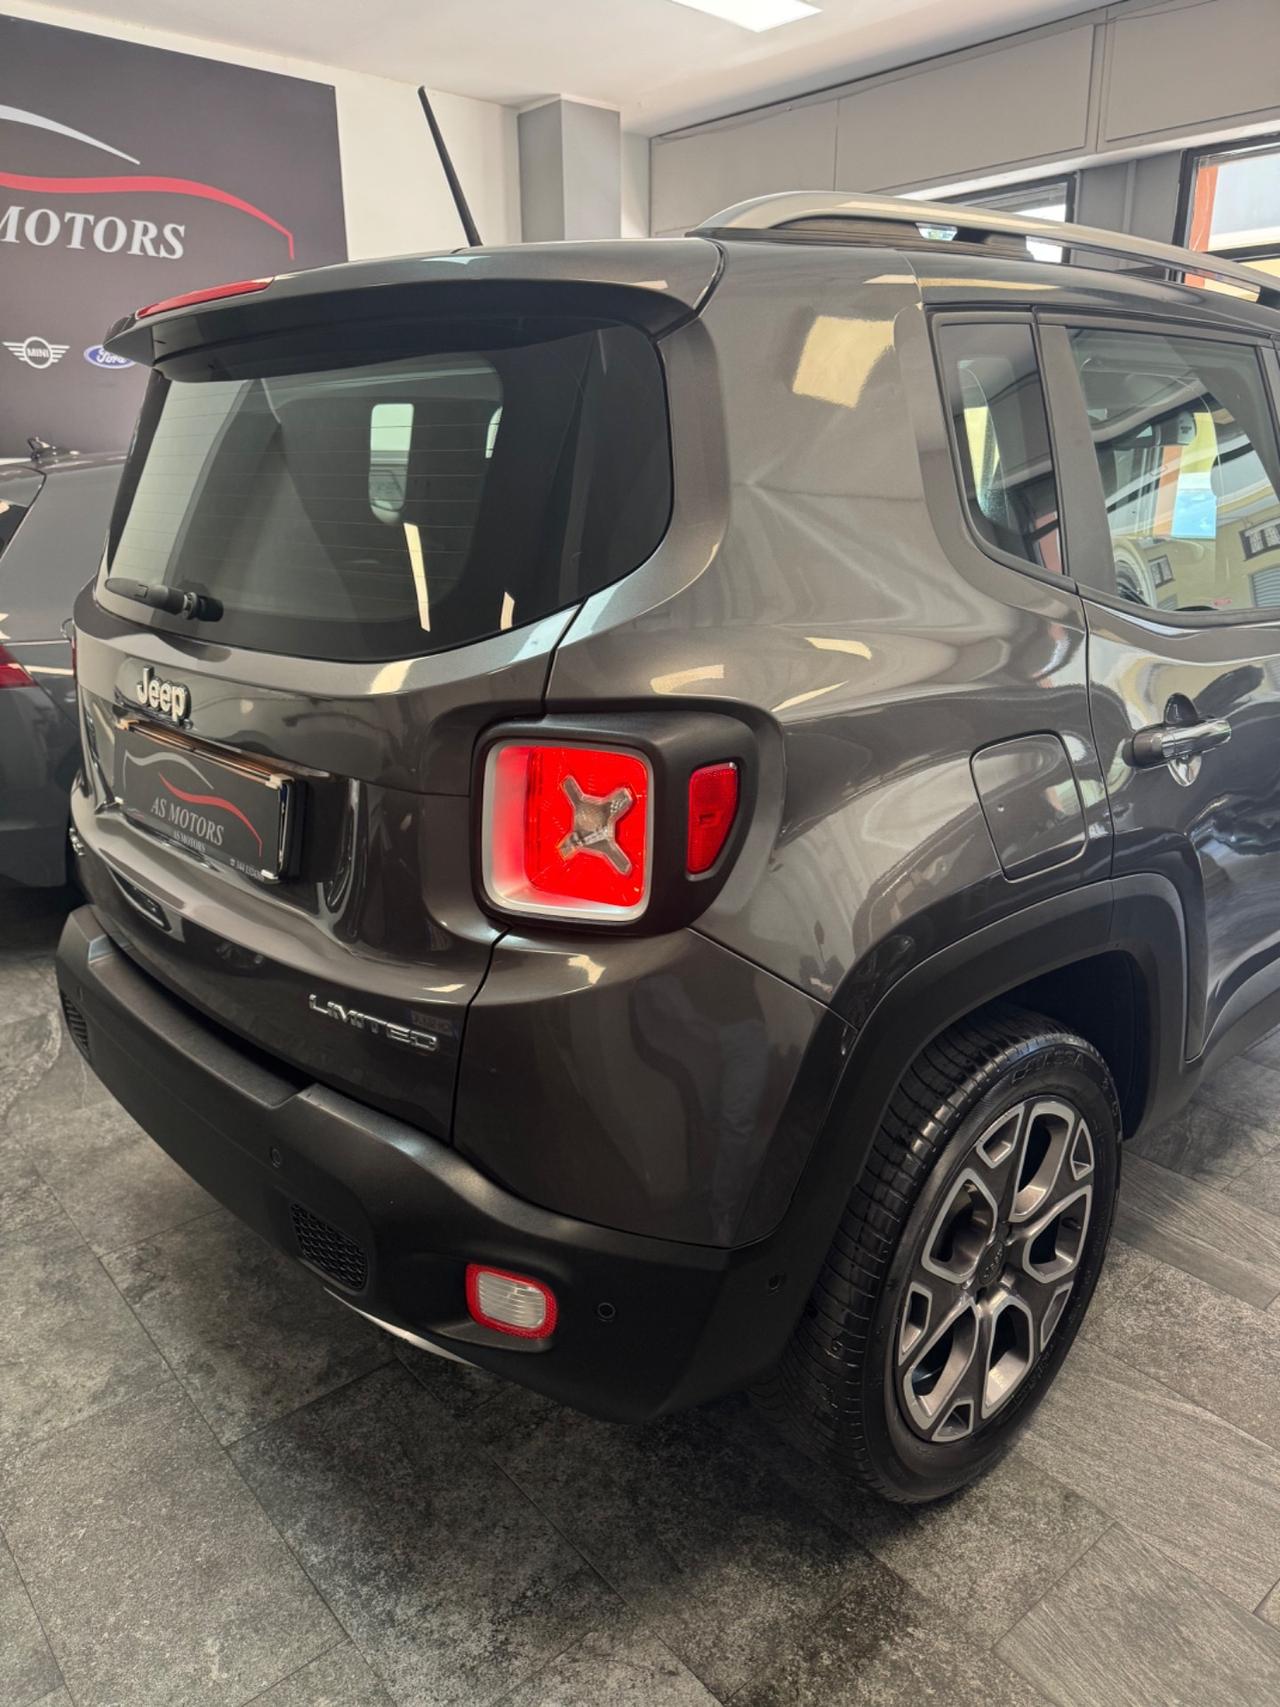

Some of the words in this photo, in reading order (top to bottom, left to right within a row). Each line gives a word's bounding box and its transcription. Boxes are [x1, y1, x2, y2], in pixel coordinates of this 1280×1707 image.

[26, 346, 49, 358] MINI
[136, 667, 187, 722] Jeep
[150, 797, 167, 819] AS
[168, 803, 224, 846] MOTORS
